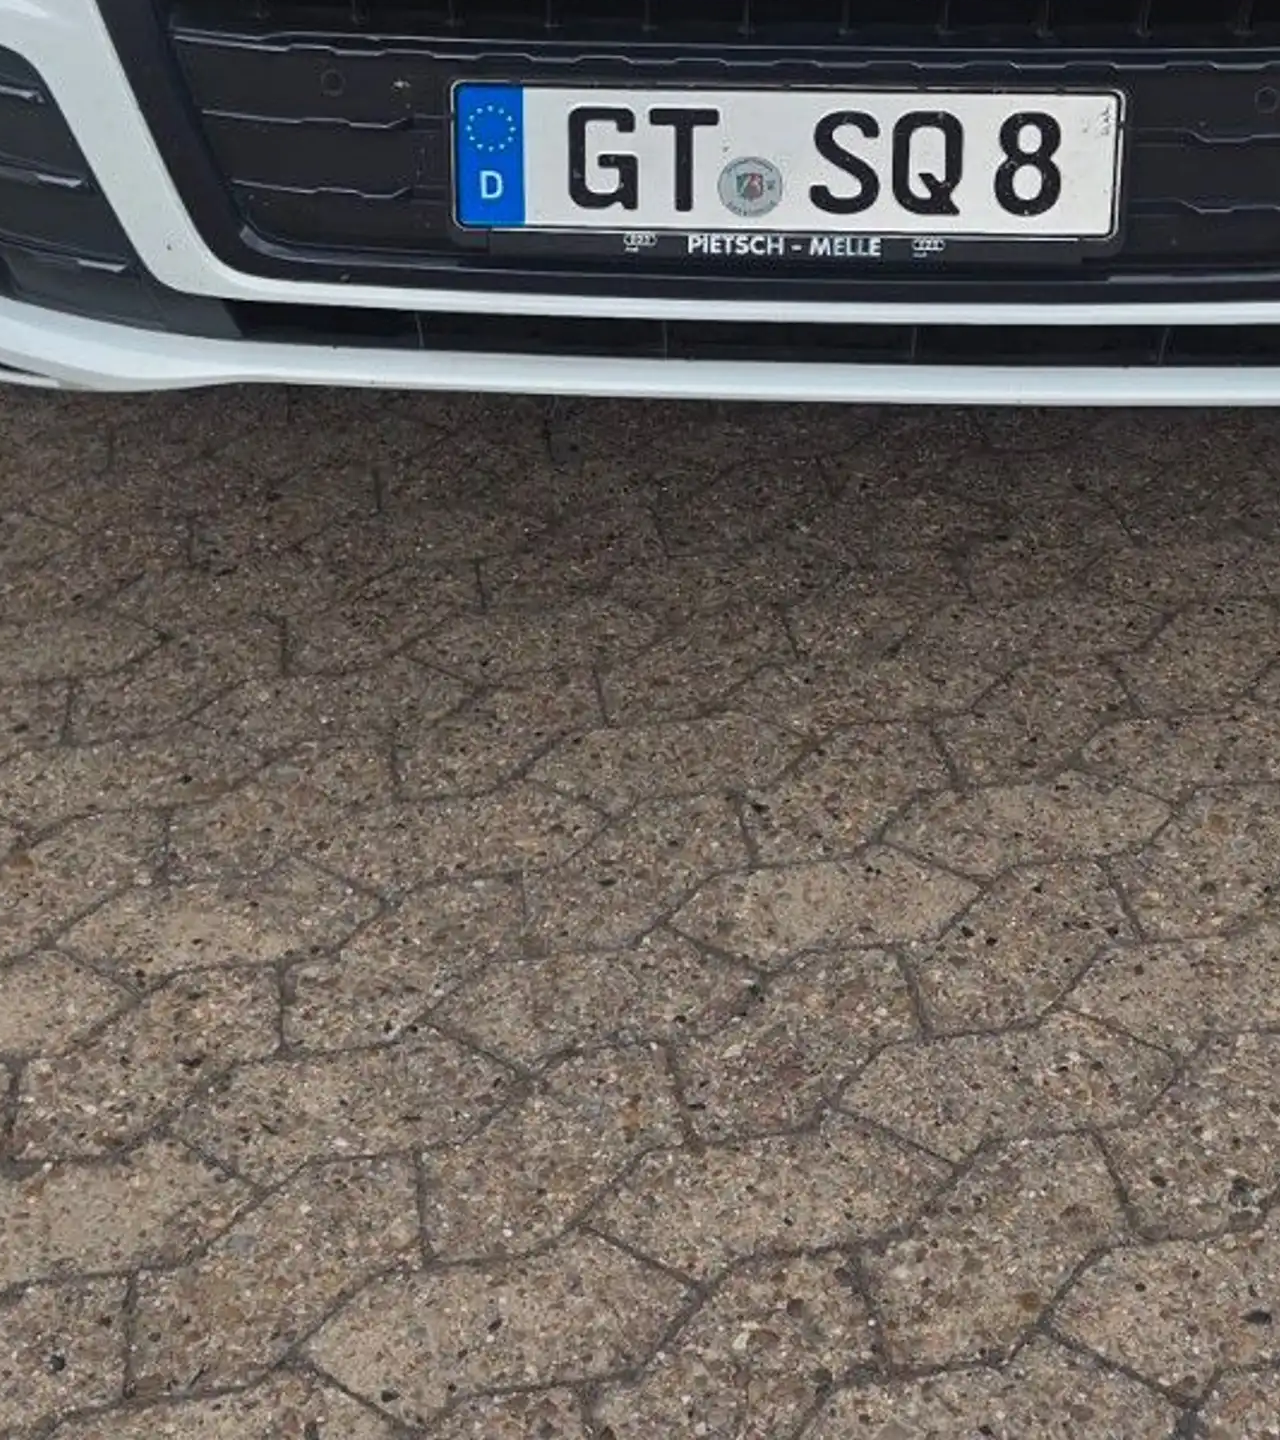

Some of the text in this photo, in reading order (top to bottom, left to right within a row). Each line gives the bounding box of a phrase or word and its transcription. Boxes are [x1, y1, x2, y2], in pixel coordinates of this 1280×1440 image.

[568, 107, 1062, 217] GT SQ 8
[479, 170, 503, 199] D
[686, 233, 783, 256] PIETSCH
[809, 236, 881, 257] MELLE
